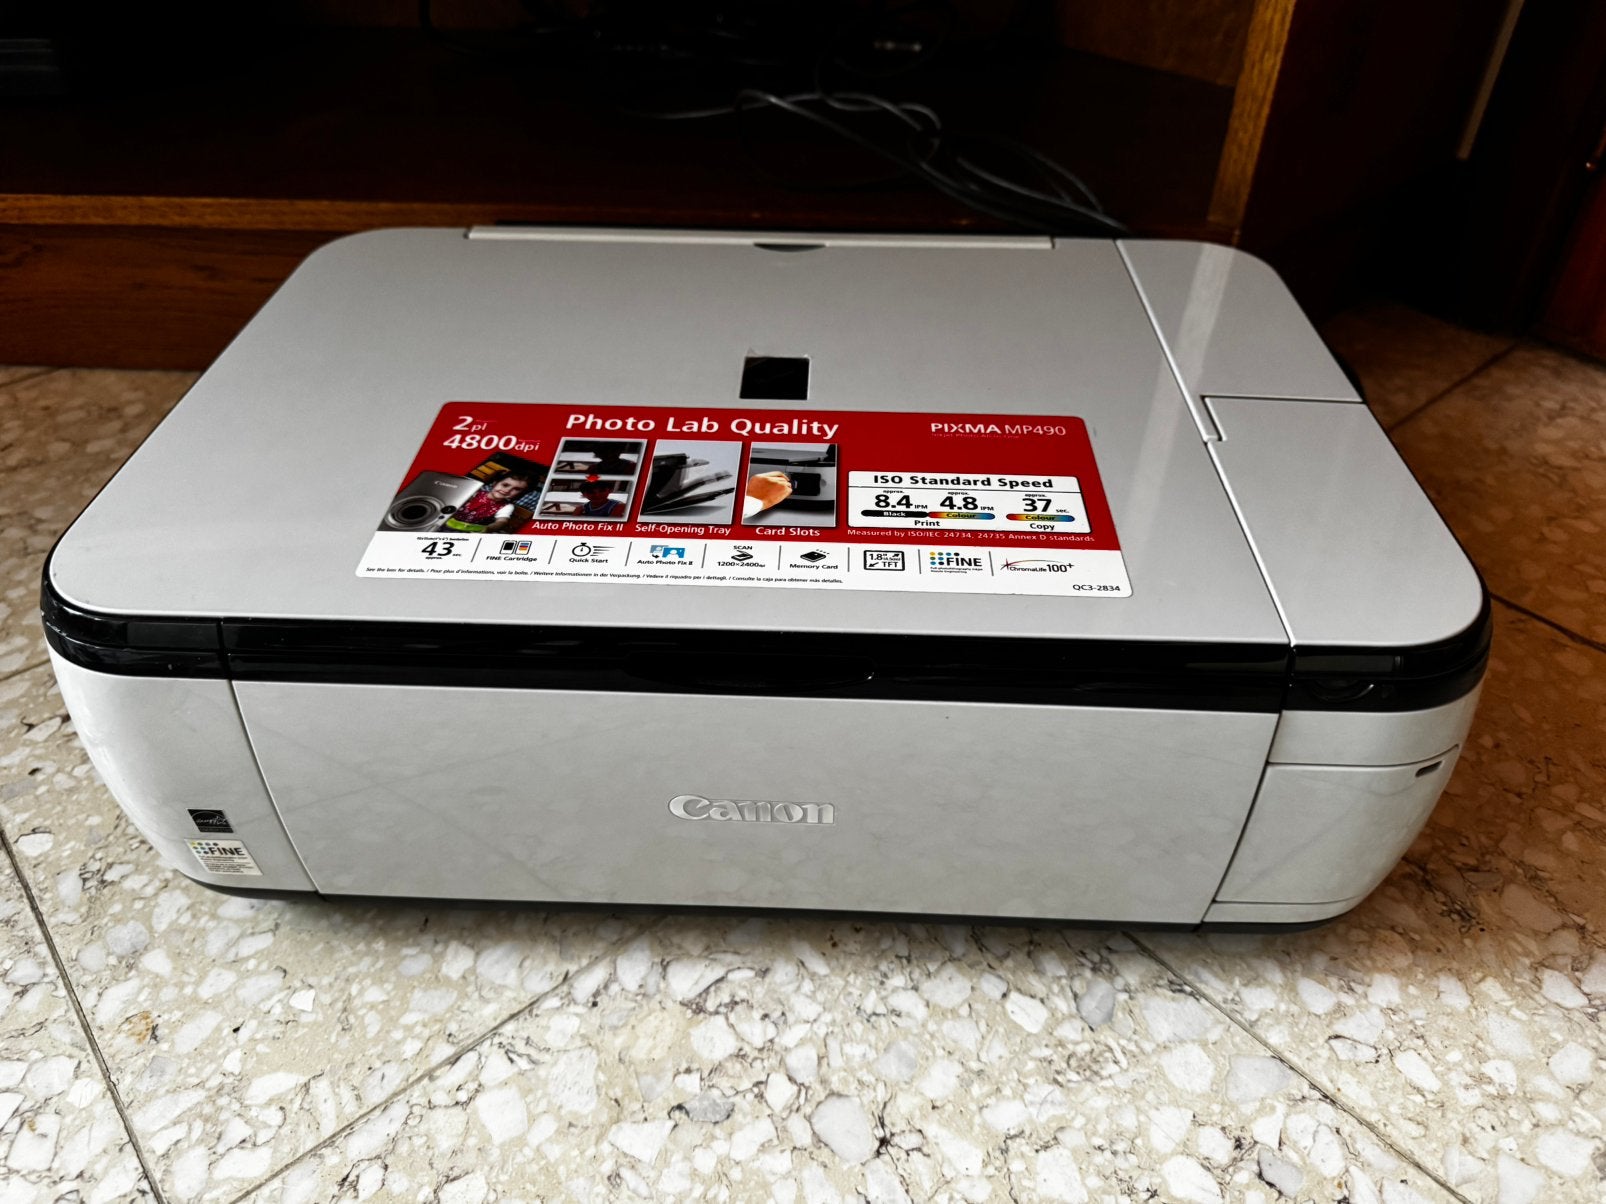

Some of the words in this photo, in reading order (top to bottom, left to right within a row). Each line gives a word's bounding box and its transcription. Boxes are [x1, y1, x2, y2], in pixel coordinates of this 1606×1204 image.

[566, 414, 655, 432] Photo
[666, 416, 719, 434] Lab
[730, 418, 839, 440] Quality
[930, 422, 1002, 434] PIXMA
[1004, 424, 1066, 436] MP490
[874, 475, 903, 484] ISO
[910, 476, 992, 486] Standard
[997, 478, 1054, 489] Speed
[874, 494, 913, 509] 8.4
[940, 496, 978, 511] 4.8
[1022, 498, 1052, 513] 37
[532, 522, 559, 531] Auto
[562, 522, 594, 531] Photo
[597, 523, 614, 532] Fix
[616, 523, 624, 532] II
[635, 523, 705, 535] Self-Opening
[708, 526, 731, 536] Tray
[755, 527, 785, 536] Card
[789, 527, 820, 537] Slots
[895, 530, 905, 538] by
[907, 530, 941, 538] ISO/IEC
[1029, 523, 1055, 531] Copy
[421, 541, 455, 557] 43
[946, 557, 983, 567] FINE
[668, 794, 835, 824] Canon
[208, 847, 245, 856] FINE
